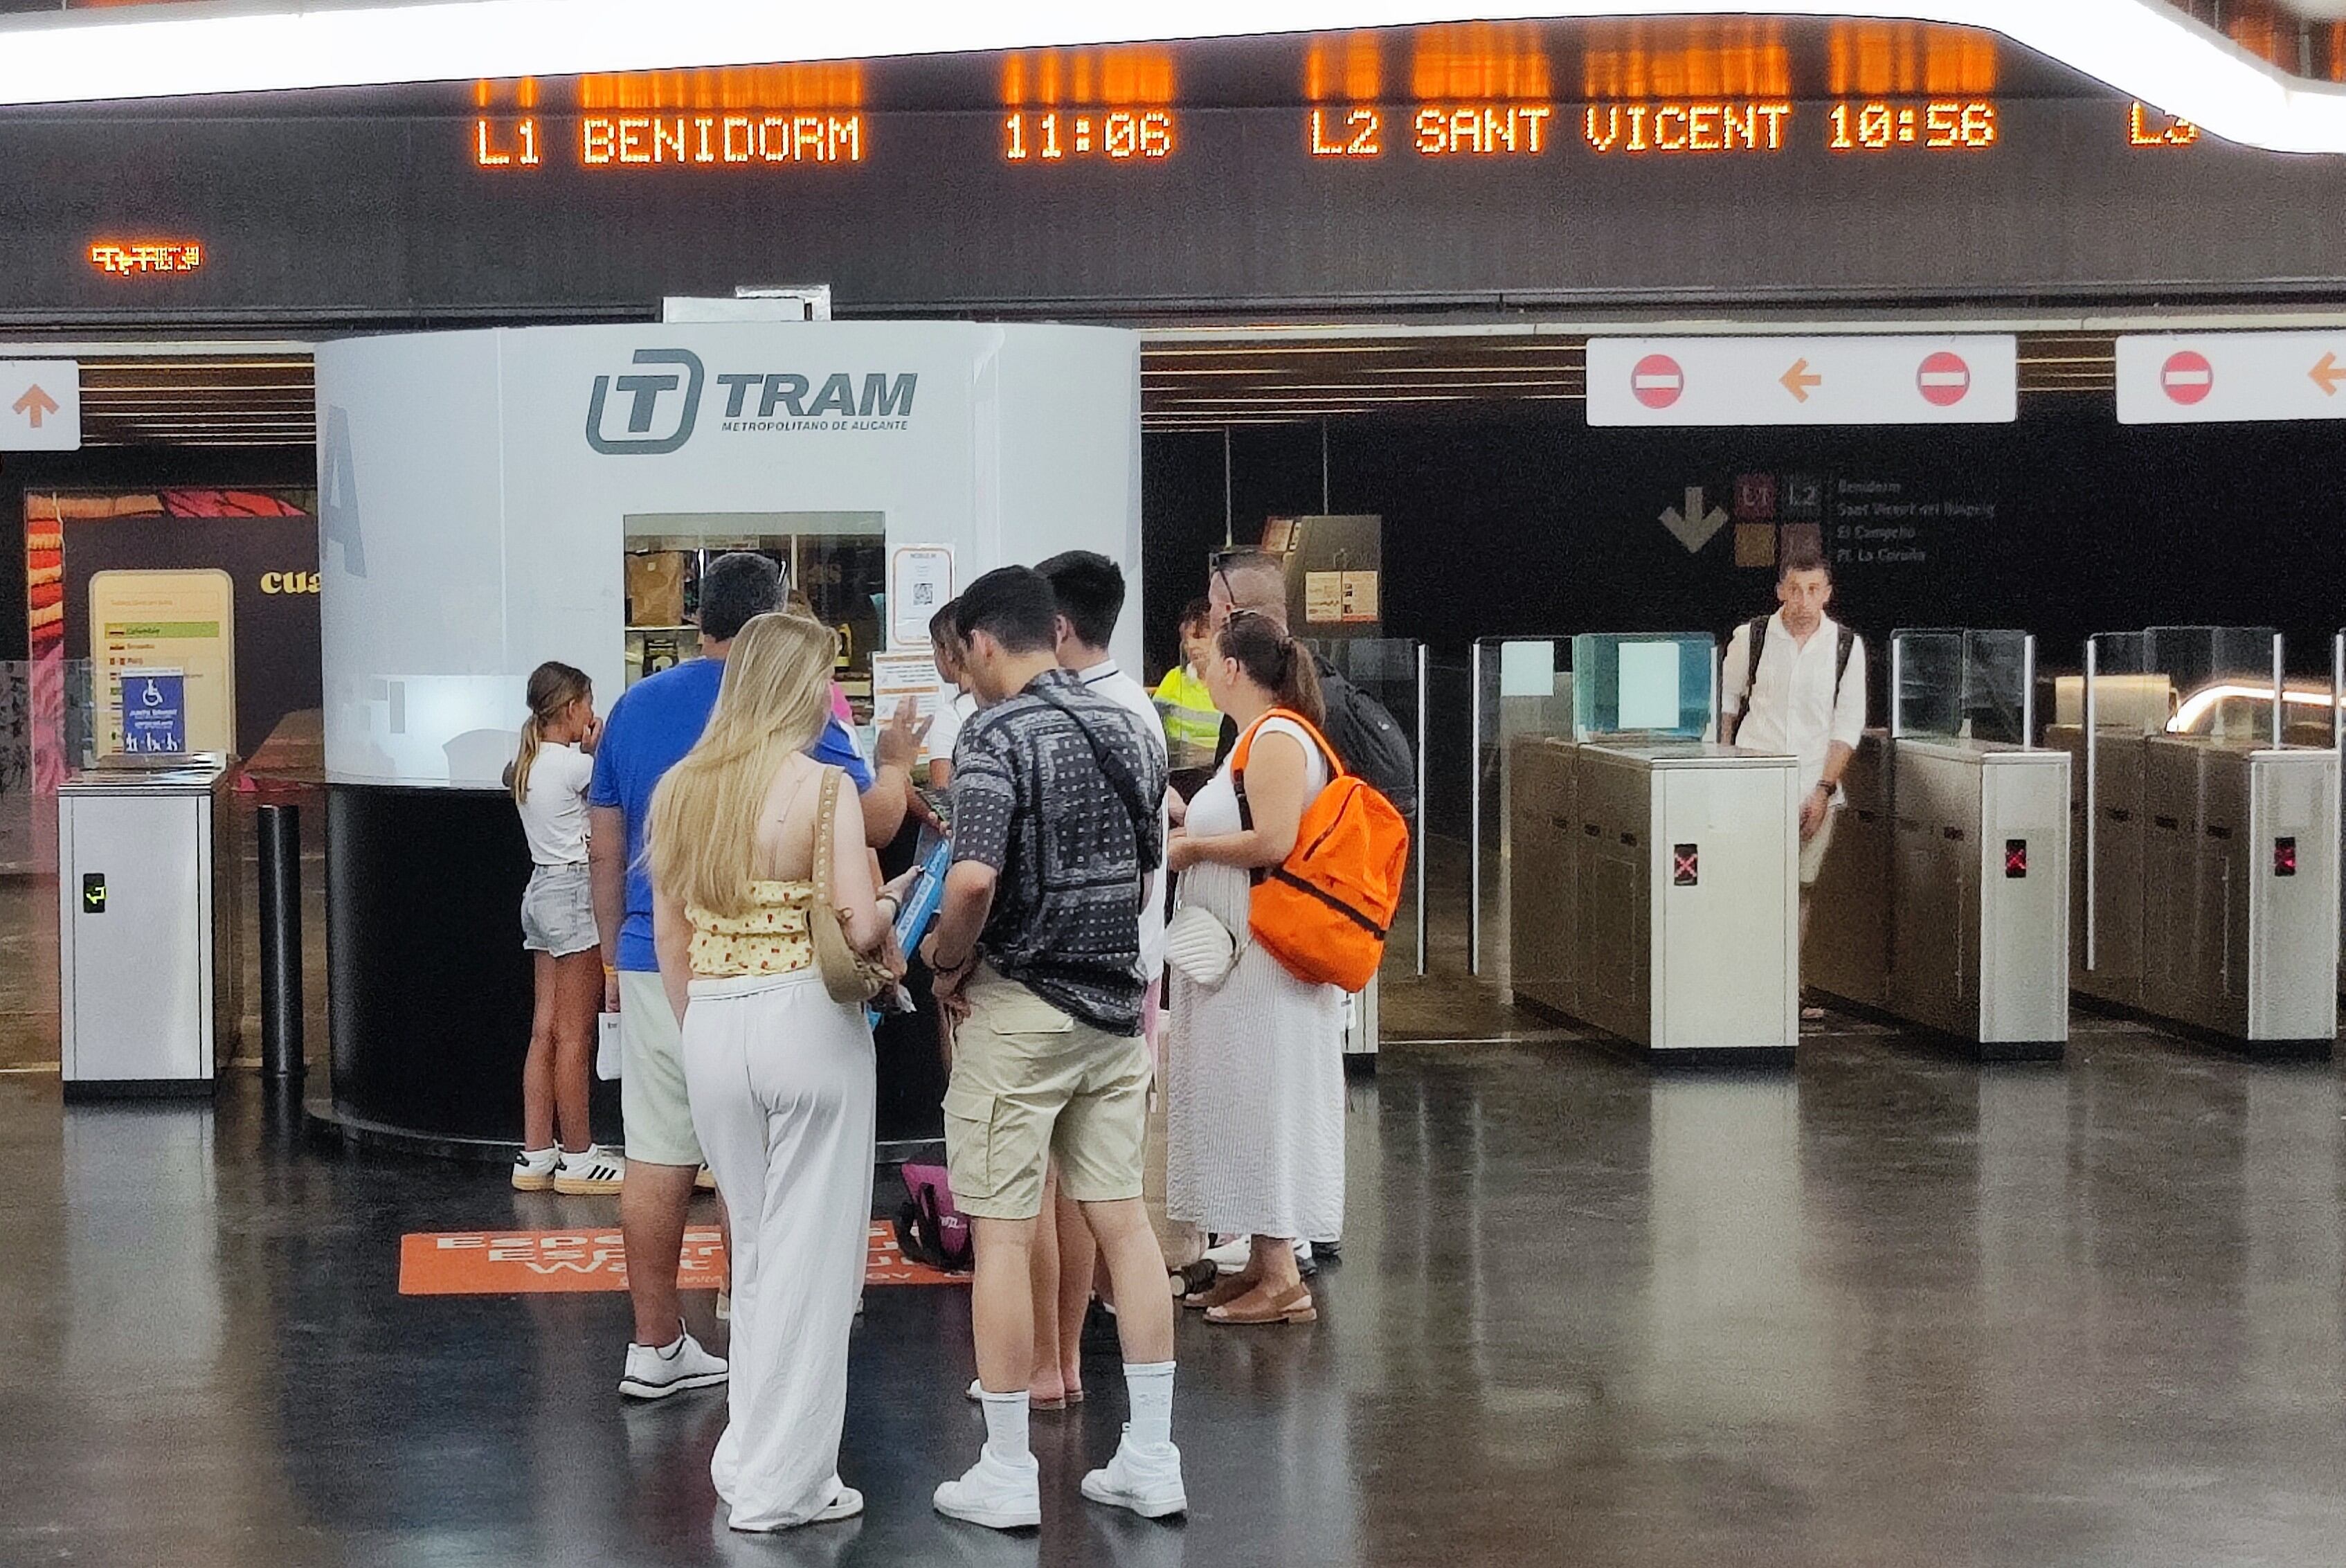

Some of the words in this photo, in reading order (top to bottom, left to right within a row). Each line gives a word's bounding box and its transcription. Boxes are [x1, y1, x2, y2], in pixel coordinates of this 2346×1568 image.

[478, 118, 539, 164] L1
[584, 116, 858, 163] BENIDORM
[1007, 111, 1171, 159] 11:06
[1312, 109, 1379, 154] L2
[1416, 106, 1550, 153] SANT
[1585, 105, 1790, 151] VICENT
[1829, 101, 1994, 149] 10:56
[716, 372, 918, 417] TRAM
[721, 421, 828, 432] METROPOLITANO
[831, 420, 848, 431] DE
[851, 420, 908, 431] ALICANTE
